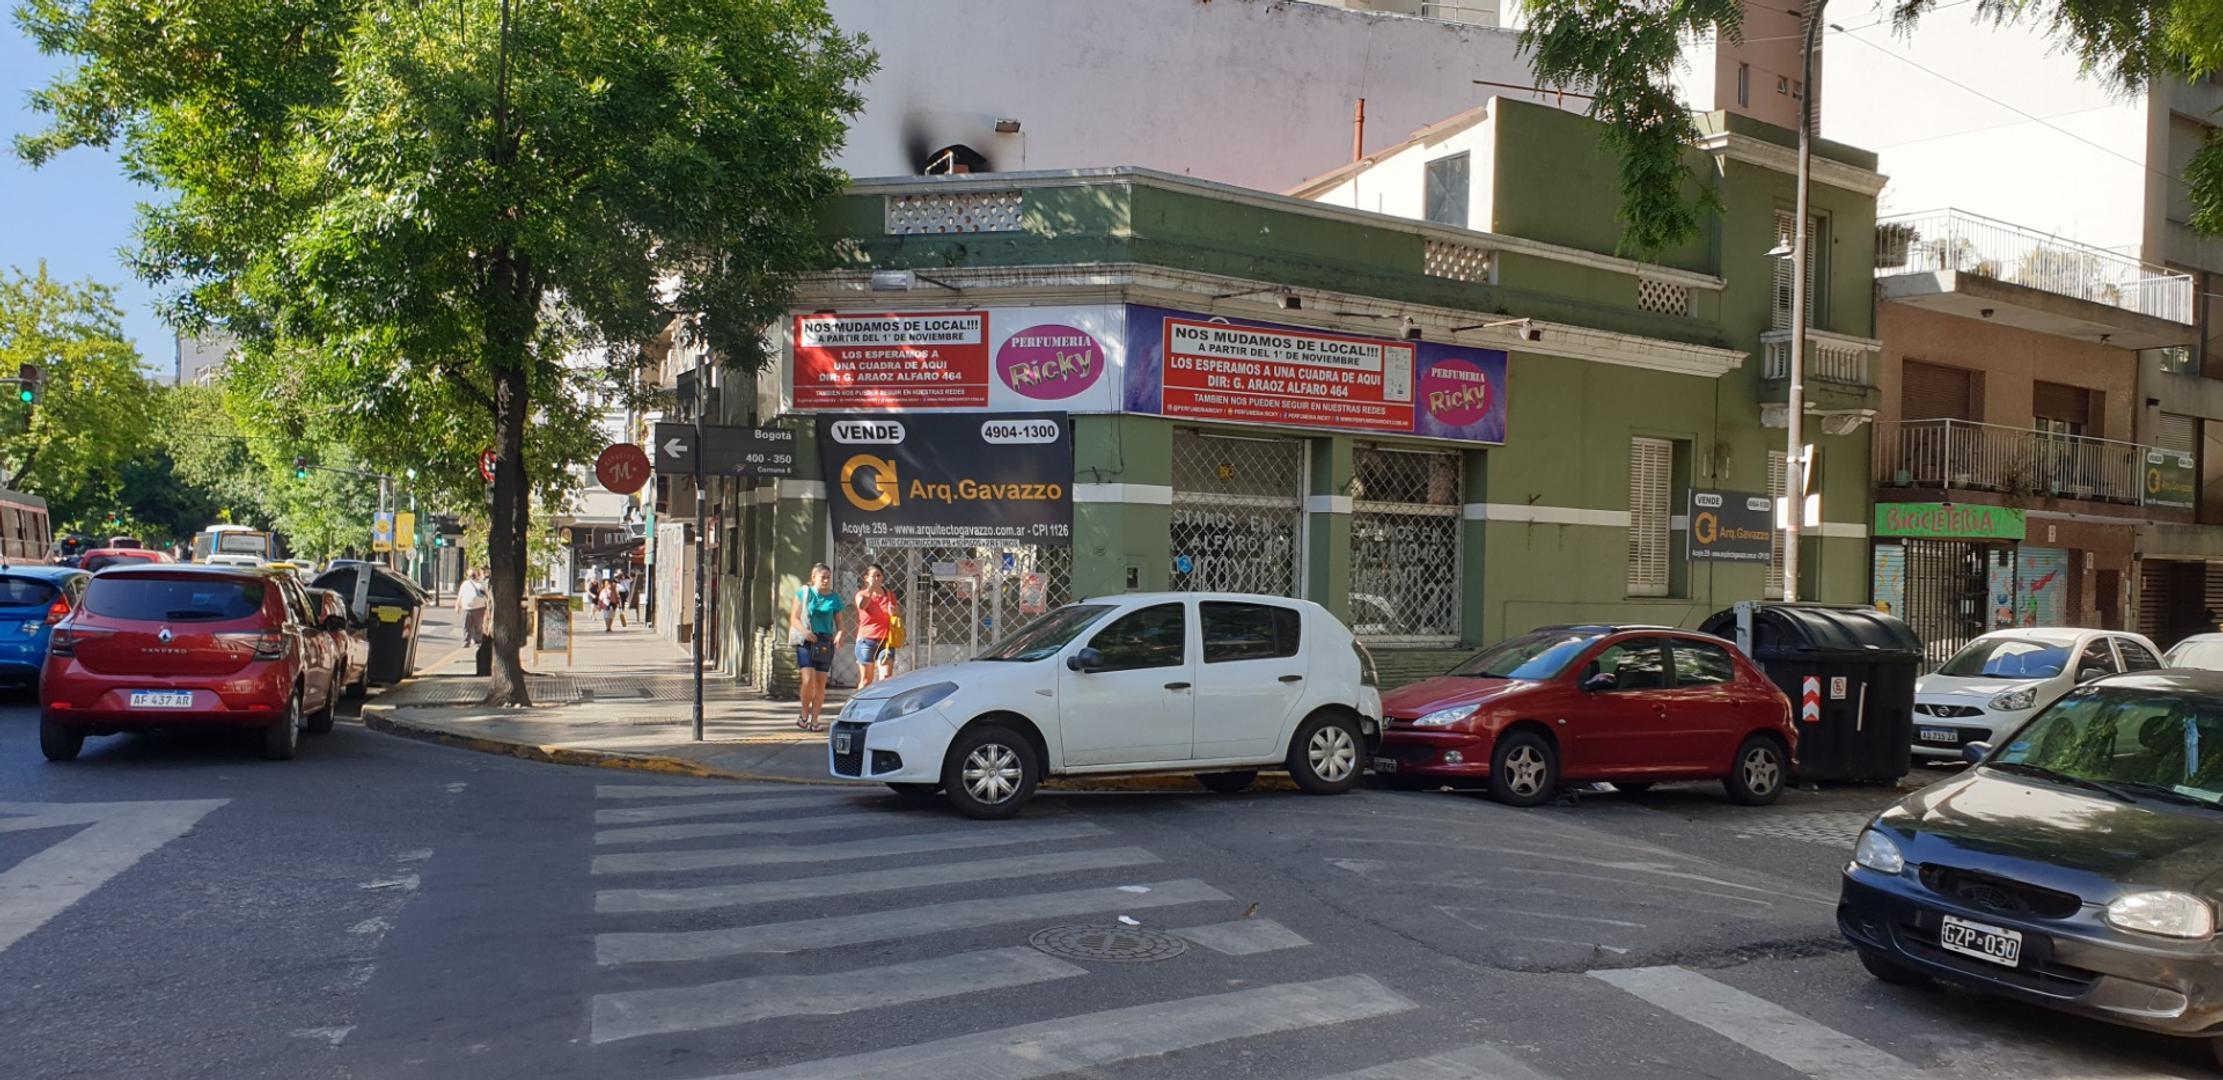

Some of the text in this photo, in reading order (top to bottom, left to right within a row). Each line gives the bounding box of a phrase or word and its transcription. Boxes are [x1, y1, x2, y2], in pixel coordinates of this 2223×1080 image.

[804, 319, 979, 333] NOS MUDAMOS DE LOCAL!!!
[818, 334, 825, 343] A
[827, 334, 855, 343] PARTIR
[862, 333, 880, 342] DEL
[894, 333, 906, 341] DE
[908, 332, 965, 341] NOVIEMBRE
[1011, 335, 1092, 348] PERFUMERIA
[1175, 327, 1379, 358] NOS MUDAMOS DE LOCAL!!!
[842, 349, 940, 359] LOS ESPERAMOS A
[1198, 342, 1206, 352] A
[1208, 343, 1247, 356] PARTIR
[1250, 348, 1270, 358] DEL
[1285, 351, 1300, 360] DE
[1302, 353, 1360, 366] NOVIEMBRE
[833, 360, 948, 370] UNA CUADRA DE AQUI
[1008, 349, 1092, 393] Ricky
[1170, 356, 1381, 386] LOS ESPERAMOS A UNA CUADRA DE AQUI
[819, 371, 962, 382] DIR: G. ARAOZ ALFARO 464
[1431, 366, 1485, 383] PERFUMERIA
[1207, 374, 1349, 398] DIR: G. ARAOZ ALFARO 464
[1193, 392, 1387, 415] TAMBIEN NOS PUEDEN SEGUIR EN NUESTRAS REDES
[1428, 383, 1486, 417] Ricky
[754, 428, 792, 441] Bogotá
[837, 424, 1056, 440] VENDE 4904-1300
[746, 453, 765, 463] 400
[773, 453, 792, 464] 350
[909, 479, 1062, 504] Arq.Gavazzo
[1697, 495, 1720, 505] VENDE
[841, 521, 871, 537] Acoyte
[871, 521, 888, 534] 259
[893, 521, 1026, 539] www.arquitectogavazzo.com.ar
[1049, 523, 1069, 537] 1126
[133, 695, 190, 705] AF 437 AR
